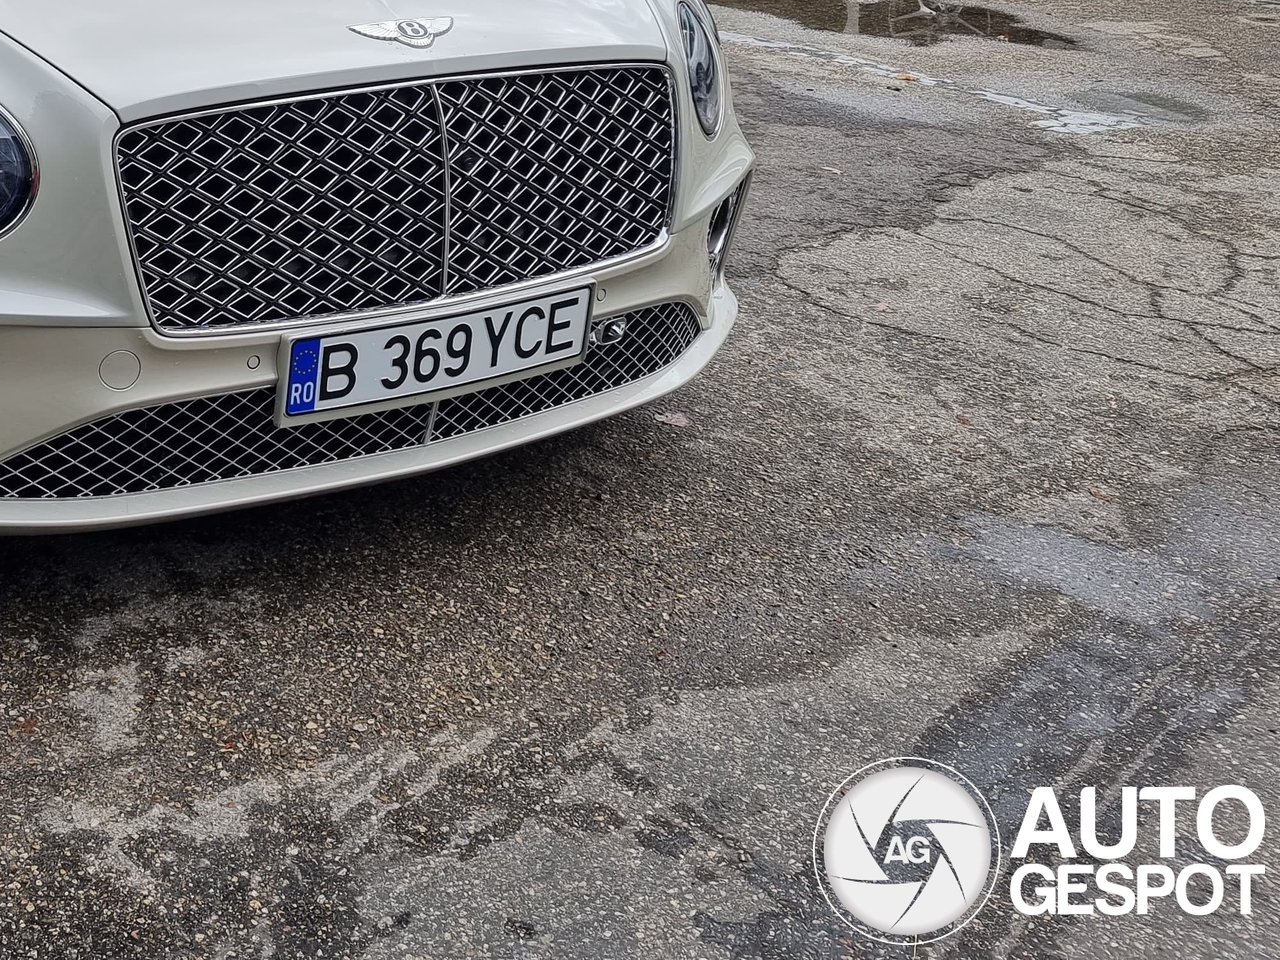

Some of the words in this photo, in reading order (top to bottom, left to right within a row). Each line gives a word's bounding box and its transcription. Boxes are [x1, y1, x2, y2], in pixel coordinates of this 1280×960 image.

[319, 342, 359, 402] B
[381, 323, 473, 391] 369
[484, 296, 580, 369] YCE
[289, 380, 314, 407] RO
